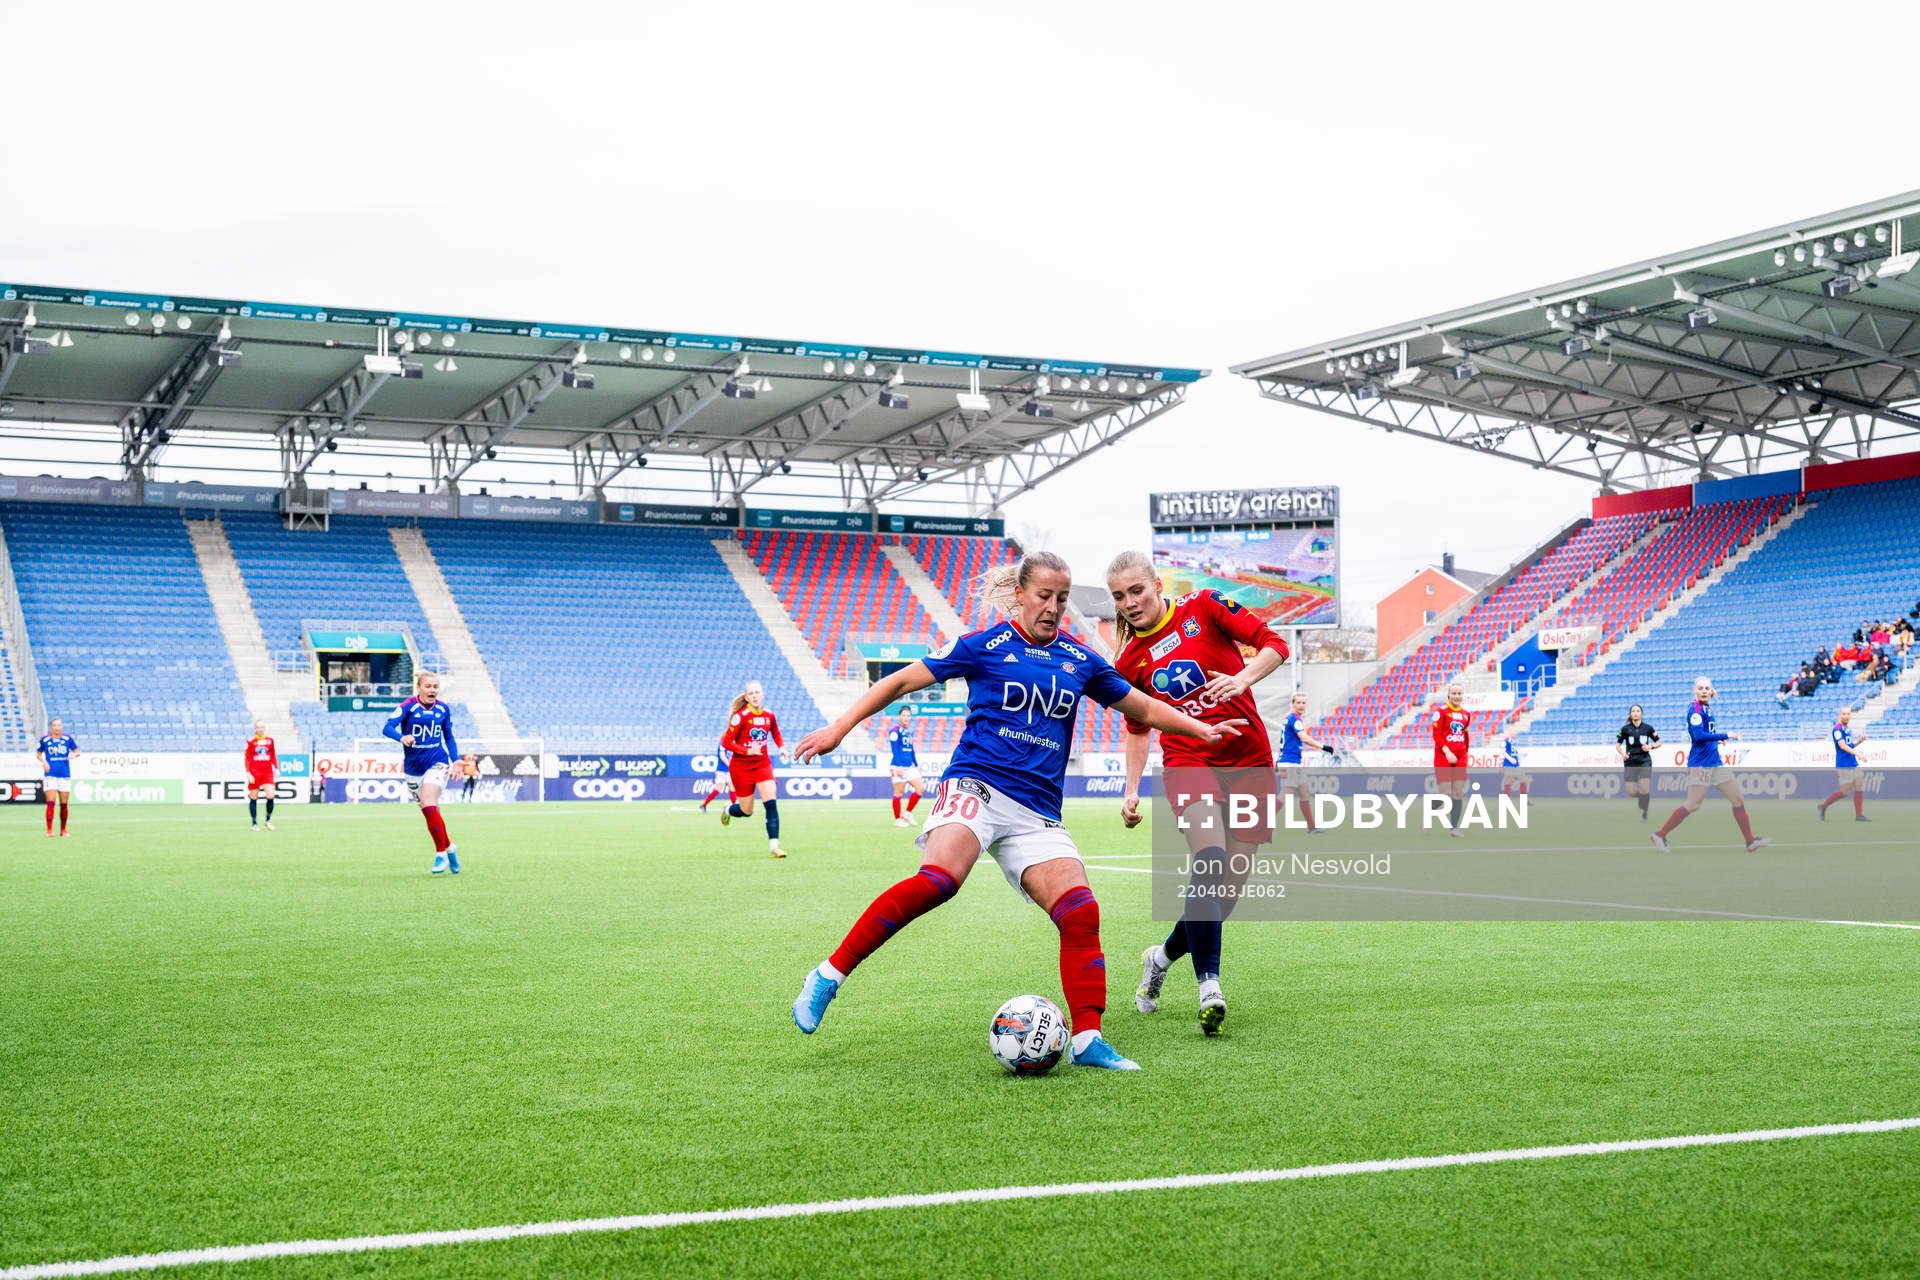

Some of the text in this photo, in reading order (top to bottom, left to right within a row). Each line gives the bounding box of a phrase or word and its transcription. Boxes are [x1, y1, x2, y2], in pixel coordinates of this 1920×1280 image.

[111, 486, 131, 498] DNB
[255, 492, 274, 504] DNB
[430, 499, 449, 512] DNB
[570, 505, 589, 518] DNB
[1159, 490, 1323, 518] intility arena
[710, 511, 728, 523] DNB
[846, 516, 863, 528] DNB
[973, 521, 990, 534] DNB
[345, 635, 369, 649] DNB
[985, 630, 1013, 650] coop
[1162, 638, 1180, 654] RSM
[1058, 641, 1088, 661] coop
[1001, 675, 1075, 724] DNB
[1173, 690, 1231, 717] OBO
[412, 720, 441, 742] DNB
[48, 743, 67, 756] DNB
[281, 758, 304, 774] DNB
[95, 781, 166, 801] fortum
[198, 781, 298, 800] TES
[572, 779, 646, 802] coop
[786, 777, 854, 800] coop
[1566, 774, 1621, 799] coop
[1736, 773, 1798, 800] coop
[942, 793, 980, 820] 30
[1029, 1011, 1052, 1054] SELECT
